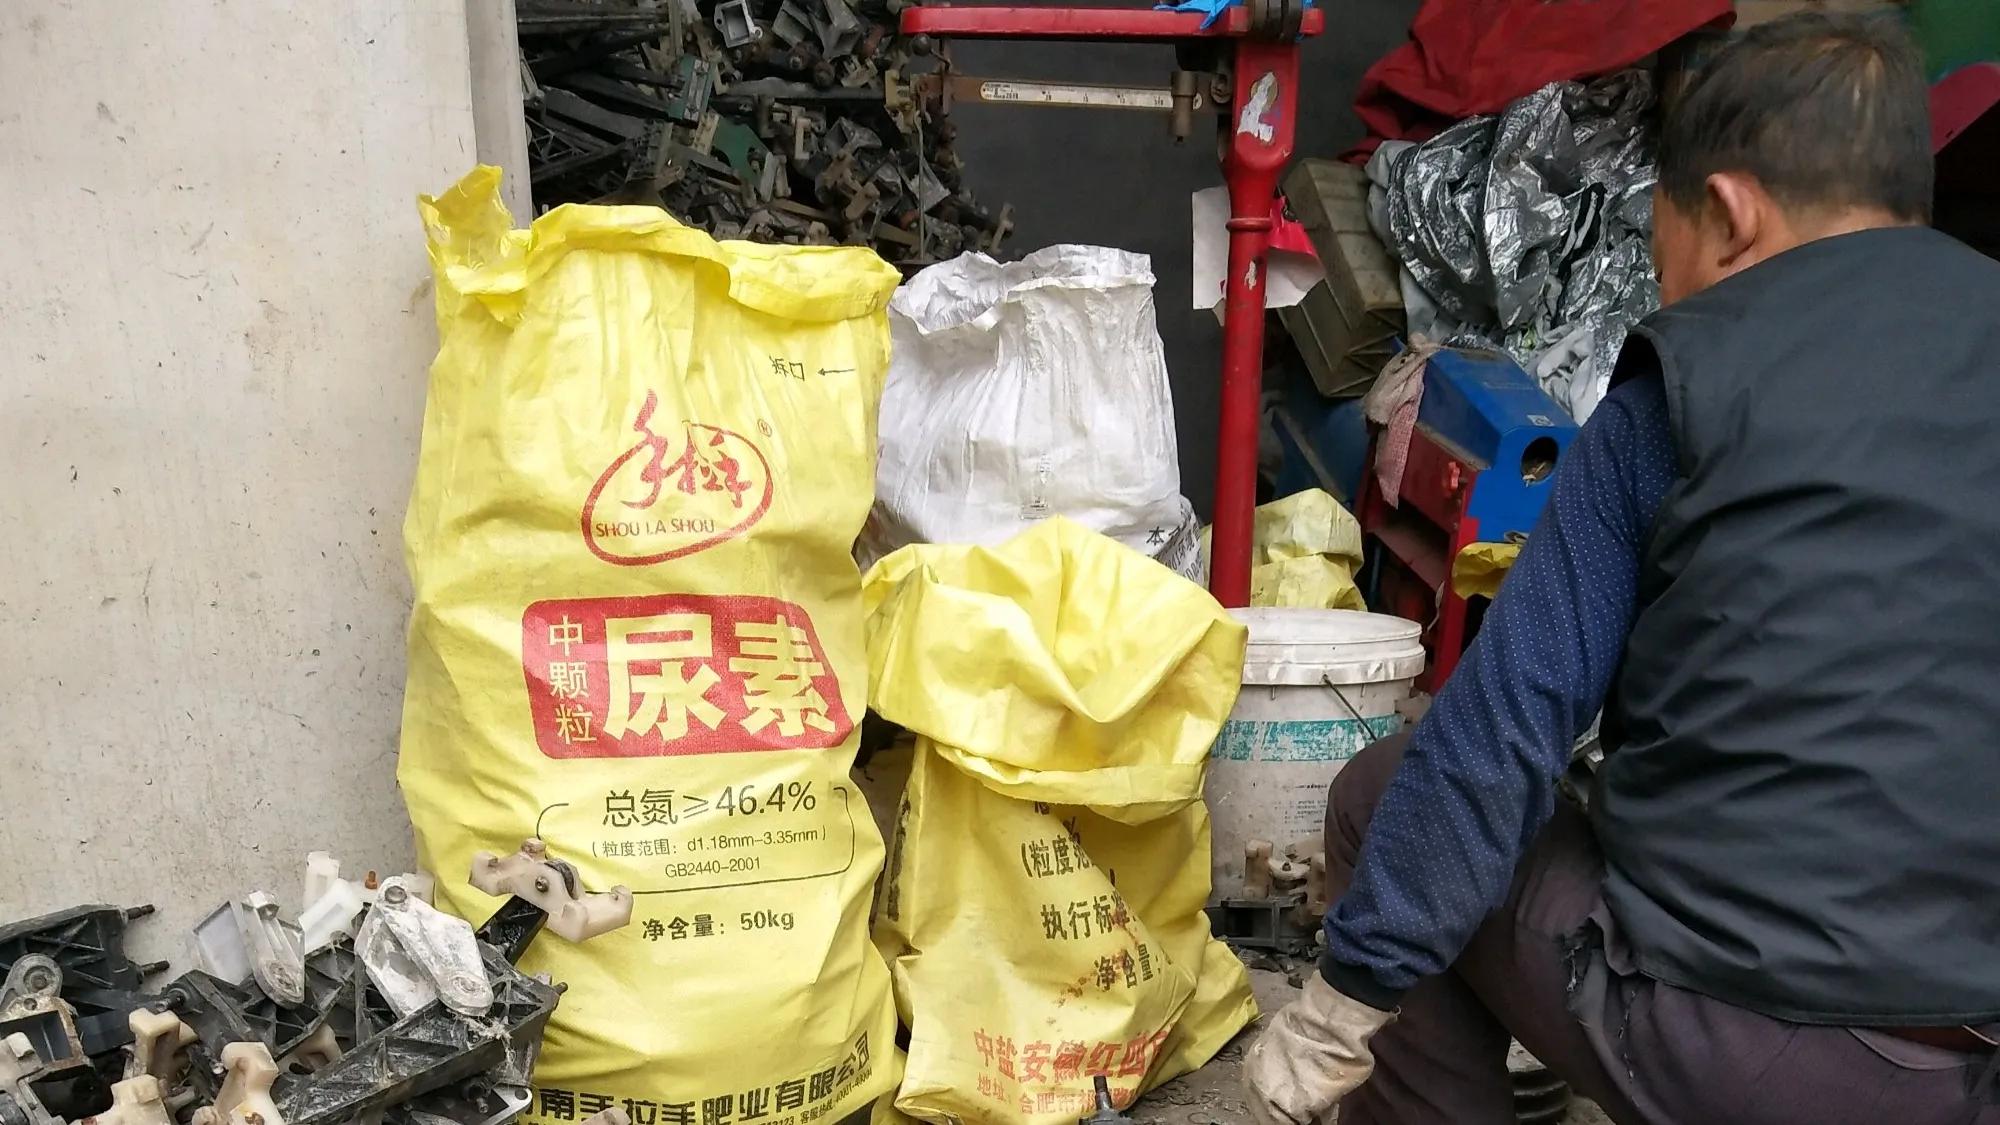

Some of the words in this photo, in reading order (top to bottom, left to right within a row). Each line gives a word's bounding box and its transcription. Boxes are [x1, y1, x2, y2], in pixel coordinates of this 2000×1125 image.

[595, 519, 640, 538] SHOU
[646, 521, 667, 536] LA
[670, 517, 715, 534] SHOU
[548, 614, 598, 745] 中颗粒
[602, 612, 837, 742] 尿素
[664, 856, 762, 879] GB2440-2001
